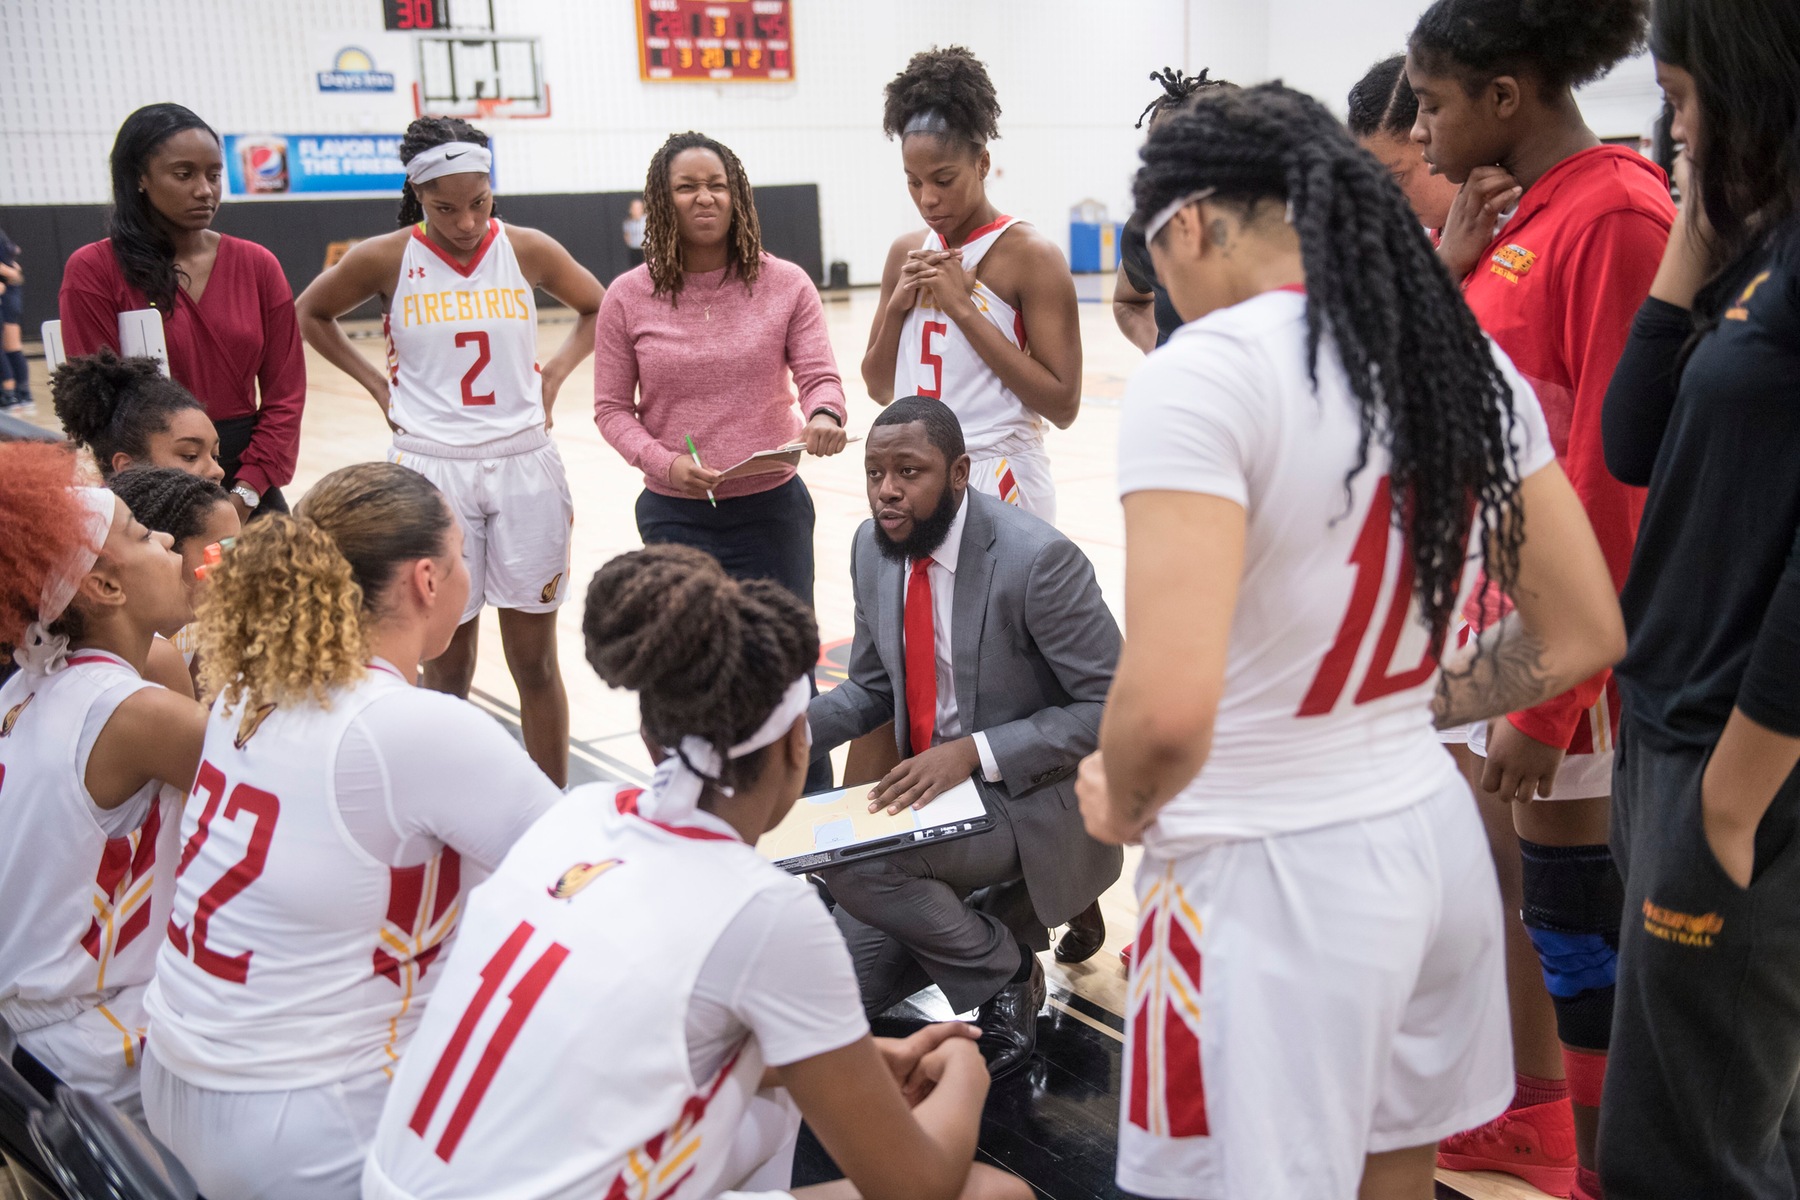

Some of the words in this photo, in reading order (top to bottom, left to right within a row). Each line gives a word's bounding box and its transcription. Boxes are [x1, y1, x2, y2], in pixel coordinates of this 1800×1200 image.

[396, 0, 434, 29] 30
[712, 16, 726, 37] 3
[679, 48, 693, 68] 3
[747, 48, 762, 69] 2
[320, 72, 360, 88] Days
[365, 73, 392, 87] Inn
[299, 139, 375, 157] FLAVOR
[301, 158, 340, 175] THE
[403, 288, 530, 328] FIREBIRDS
[454, 331, 496, 406] 2
[917, 320, 948, 400] 5
[1293, 472, 1479, 719] 10
[167, 758, 281, 985] 22
[409, 919, 571, 1165] 11
